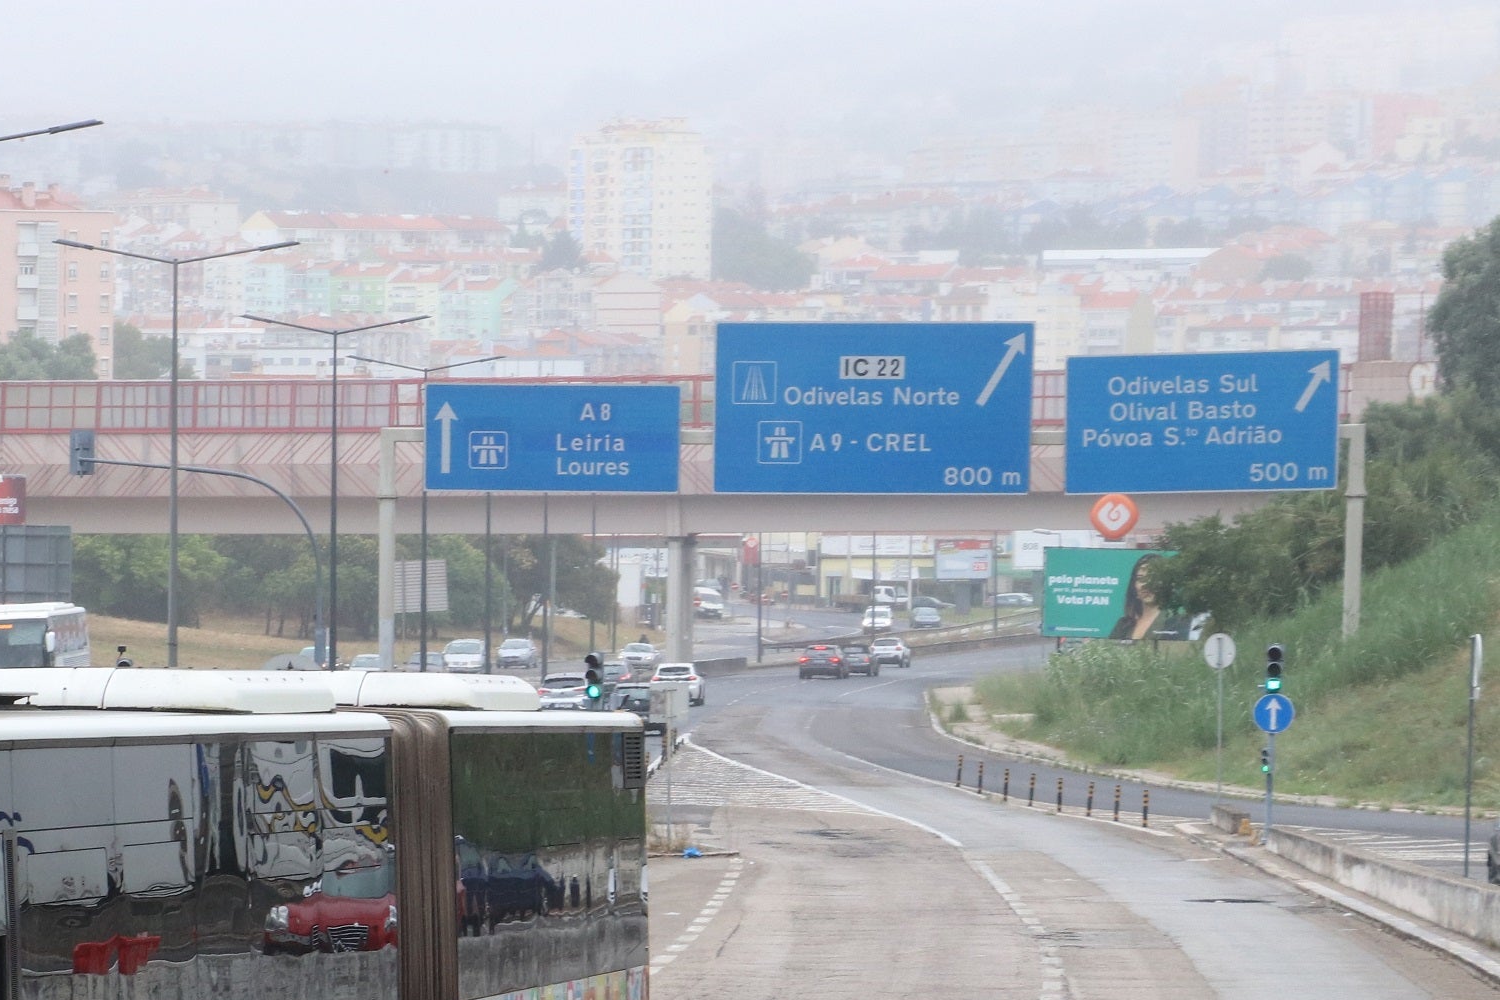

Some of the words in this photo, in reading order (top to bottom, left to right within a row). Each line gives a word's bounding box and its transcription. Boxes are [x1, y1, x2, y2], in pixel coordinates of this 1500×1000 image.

[844, 358, 869, 377] IC
[877, 358, 901, 377] 22
[1108, 376, 1209, 395] Odivelas
[1219, 374, 1259, 393] Sul
[784, 386, 882, 406] Odivelas
[894, 387, 960, 406] Norte
[1109, 402, 1177, 422] Olival
[1188, 400, 1256, 420] Basto
[556, 433, 625, 452] Leiria
[866, 433, 932, 451] CREL
[1082, 428, 1152, 447] Póvoa
[1205, 425, 1282, 445] Adrião
[556, 457, 630, 476] Loures
[1249, 462, 1298, 481] 500
[1308, 465, 1328, 481] m
[944, 467, 992, 486] 800
[1002, 471, 1021, 486] m
[1074, 575, 1119, 587] planeta
[1057, 595, 1083, 604] Vota
[1085, 595, 1109, 605] PAN
